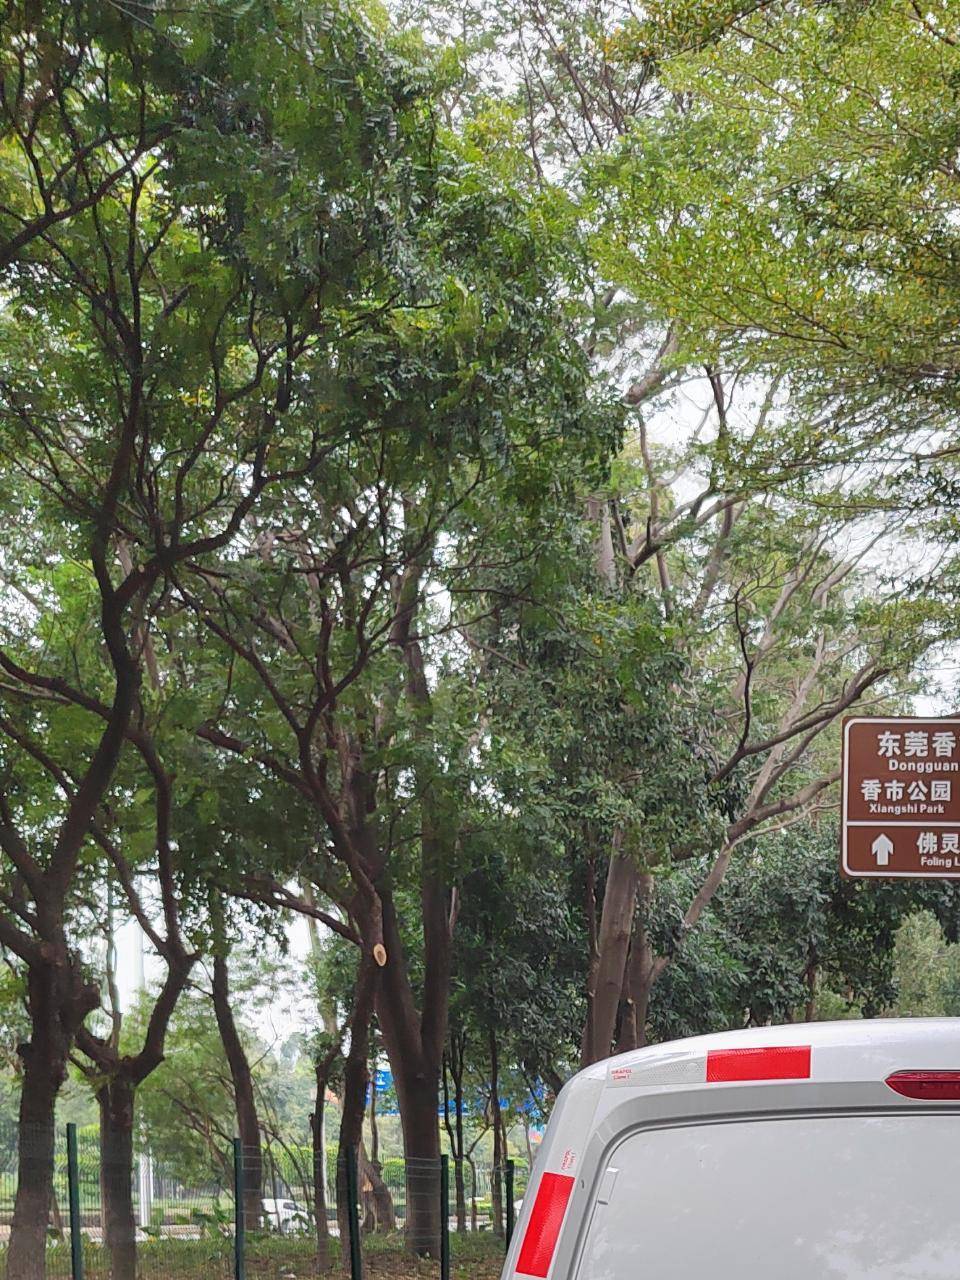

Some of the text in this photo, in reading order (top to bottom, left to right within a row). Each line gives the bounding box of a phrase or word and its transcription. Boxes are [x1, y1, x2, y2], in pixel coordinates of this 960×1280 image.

[888, 759, 959, 774] Dongguan
[861, 779, 951, 802] 香市公园
[869, 803, 945, 815] Xiangshi Park
[920, 857, 952, 868] Foling
